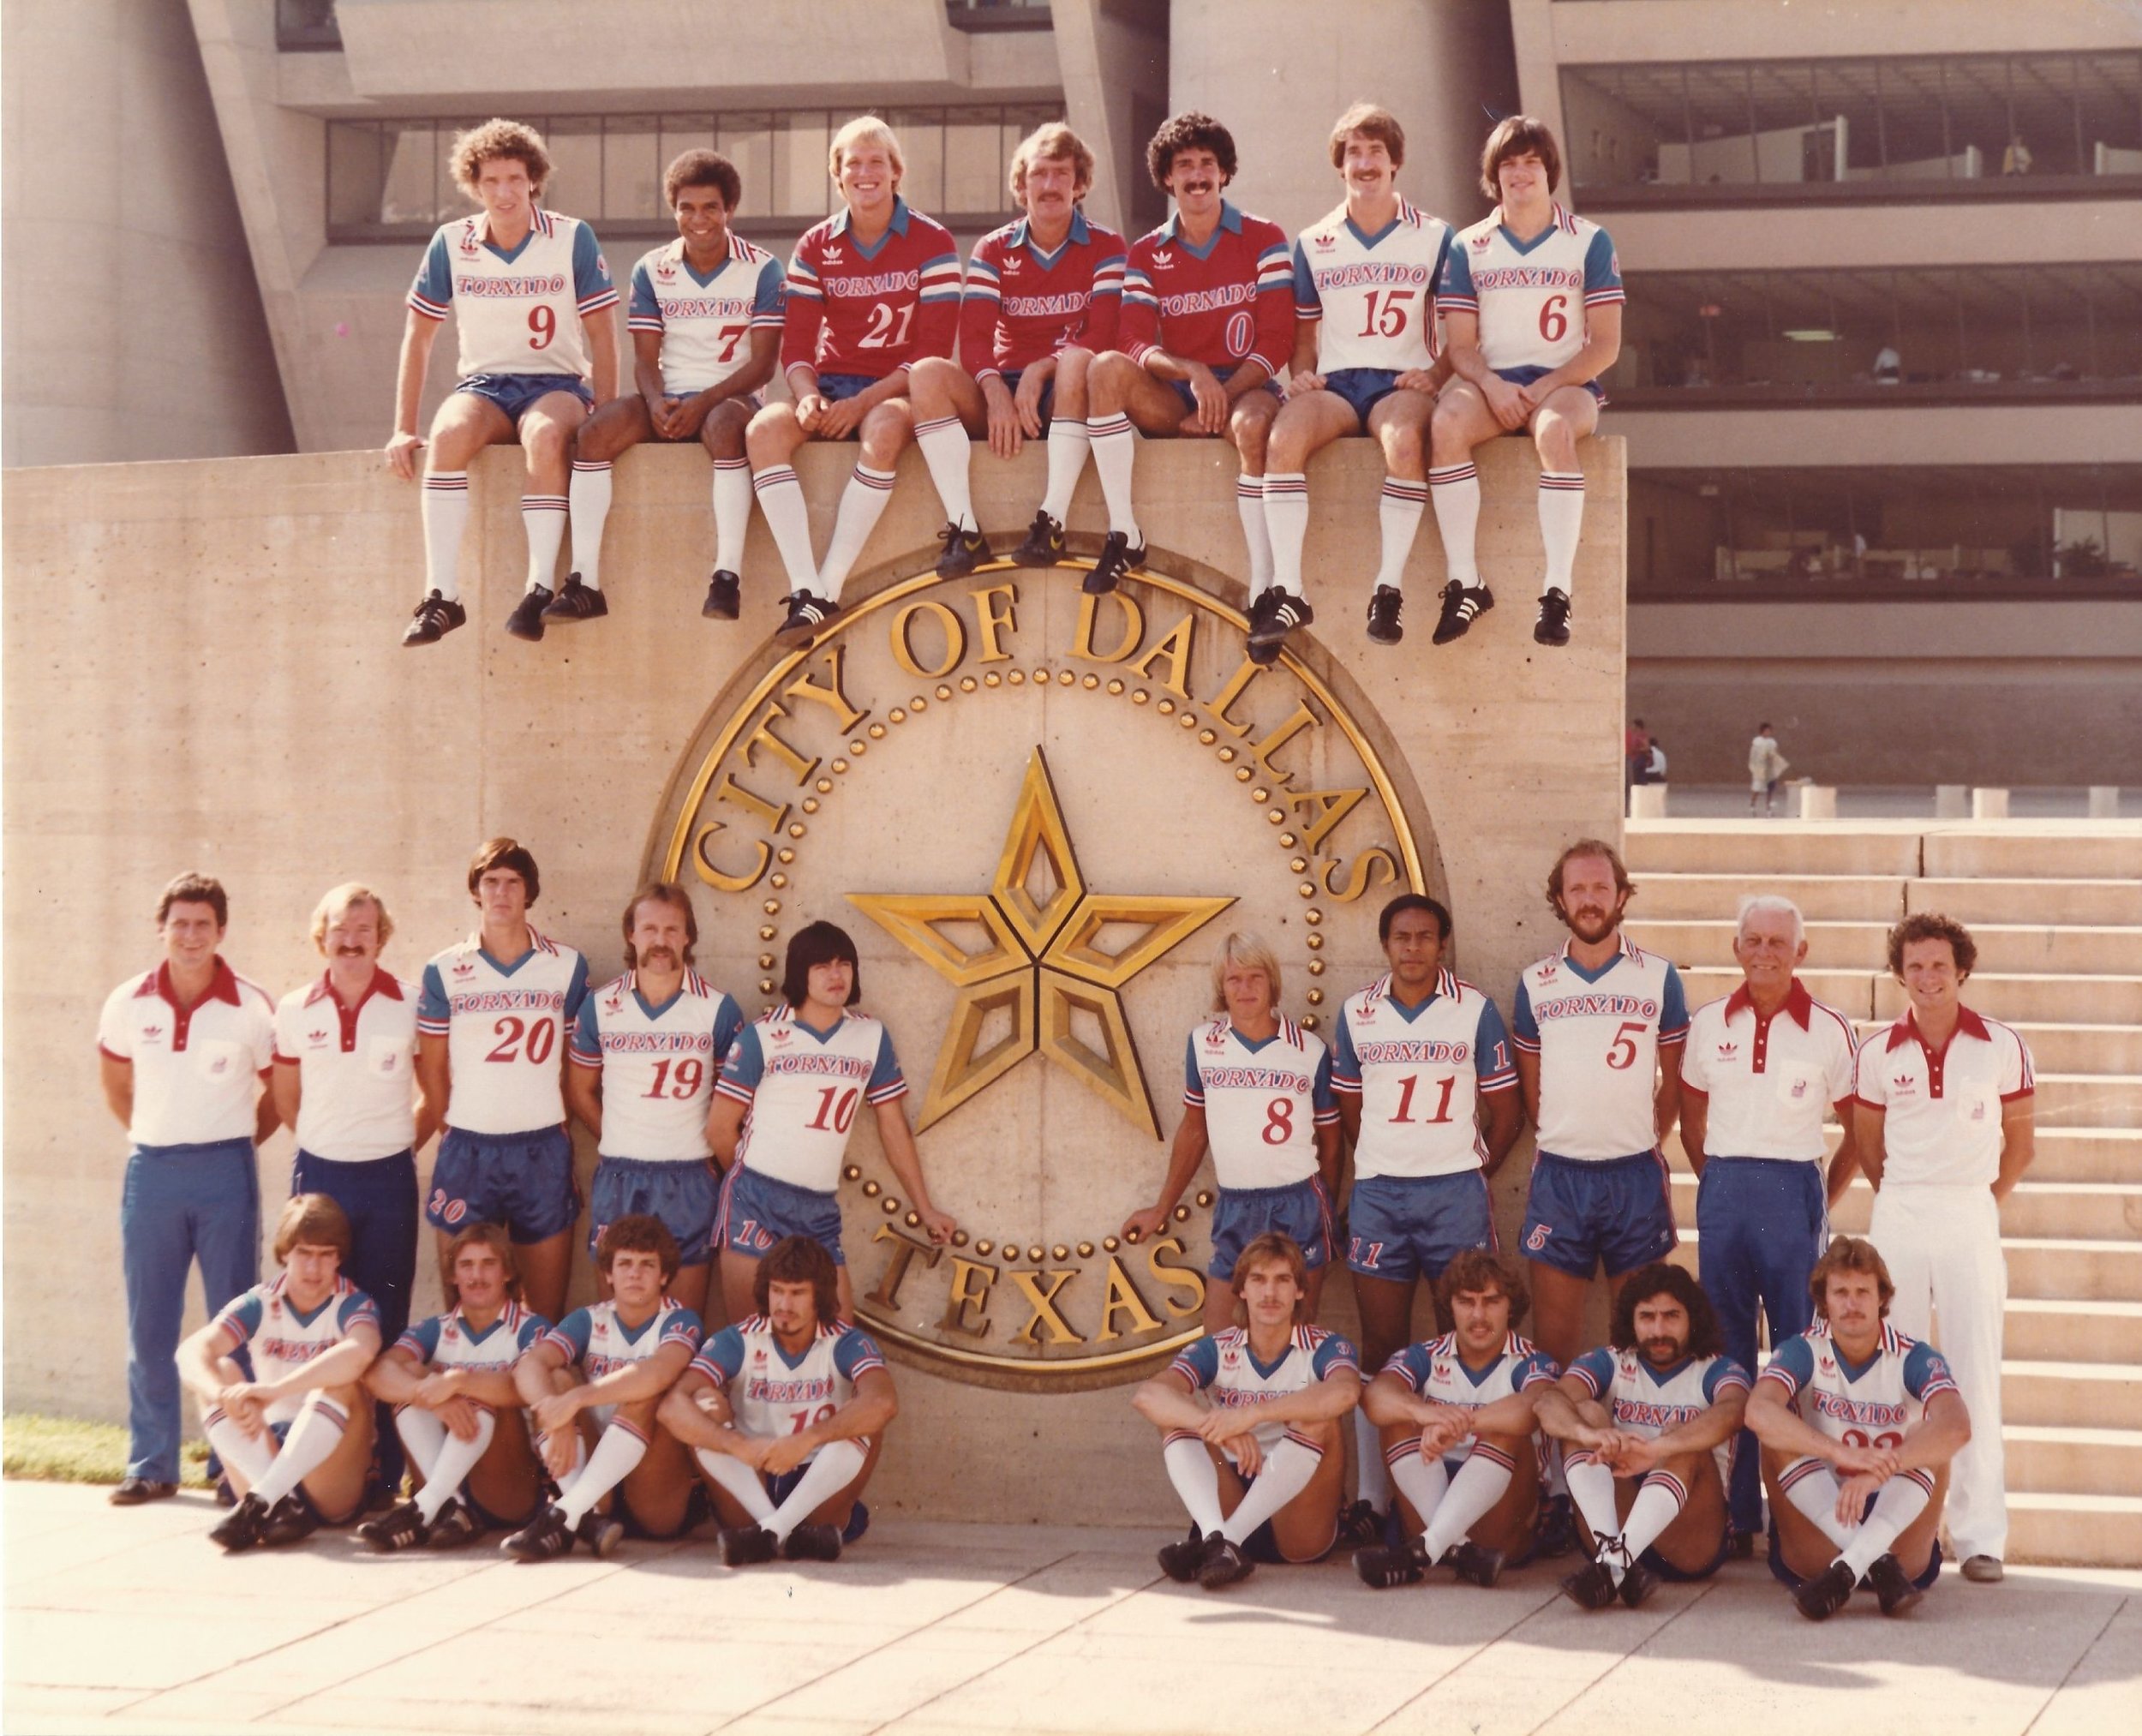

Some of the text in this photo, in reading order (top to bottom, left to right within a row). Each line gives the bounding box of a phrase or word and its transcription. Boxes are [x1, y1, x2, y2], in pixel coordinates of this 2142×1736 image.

[458, 274, 566, 297] TORNADO
[822, 270, 919, 298] TORNADO
[1315, 261, 1428, 291] TORNADO
[1472, 265, 1583, 292] TORNADO
[1158, 281, 1258, 318] TORNADO
[1358, 290, 1415, 338] 15
[528, 305, 556, 350] 9
[858, 301, 915, 348] 21
[1226, 311, 1254, 357] 0
[1539, 295, 1567, 343] 6
[717, 325, 750, 363] 7
[692, 584, 1399, 903] CITY OF DALLAS
[451, 990, 564, 1015] TORNADO
[1535, 994, 1658, 1024] TORNADO
[484, 1016, 554, 1065] 20
[599, 1032, 713, 1053] TORNADO
[1356, 1041, 1469, 1066] TORNADO
[1493, 1039, 1511, 1071] 1
[1606, 1021, 1648, 1070] 5
[640, 1057, 703, 1100] 19
[766, 1053, 873, 1082] TORNADO
[1200, 1066, 1311, 1095] TORNADO
[804, 1086, 859, 1134] 10
[1388, 1074, 1456, 1123] 11
[1261, 1097, 1294, 1145] 8
[429, 1188, 467, 1224] 20
[1349, 1237, 1383, 1268] 11
[1527, 1224, 1553, 1250] 5
[865, 1222, 1206, 1345] TEXAS
